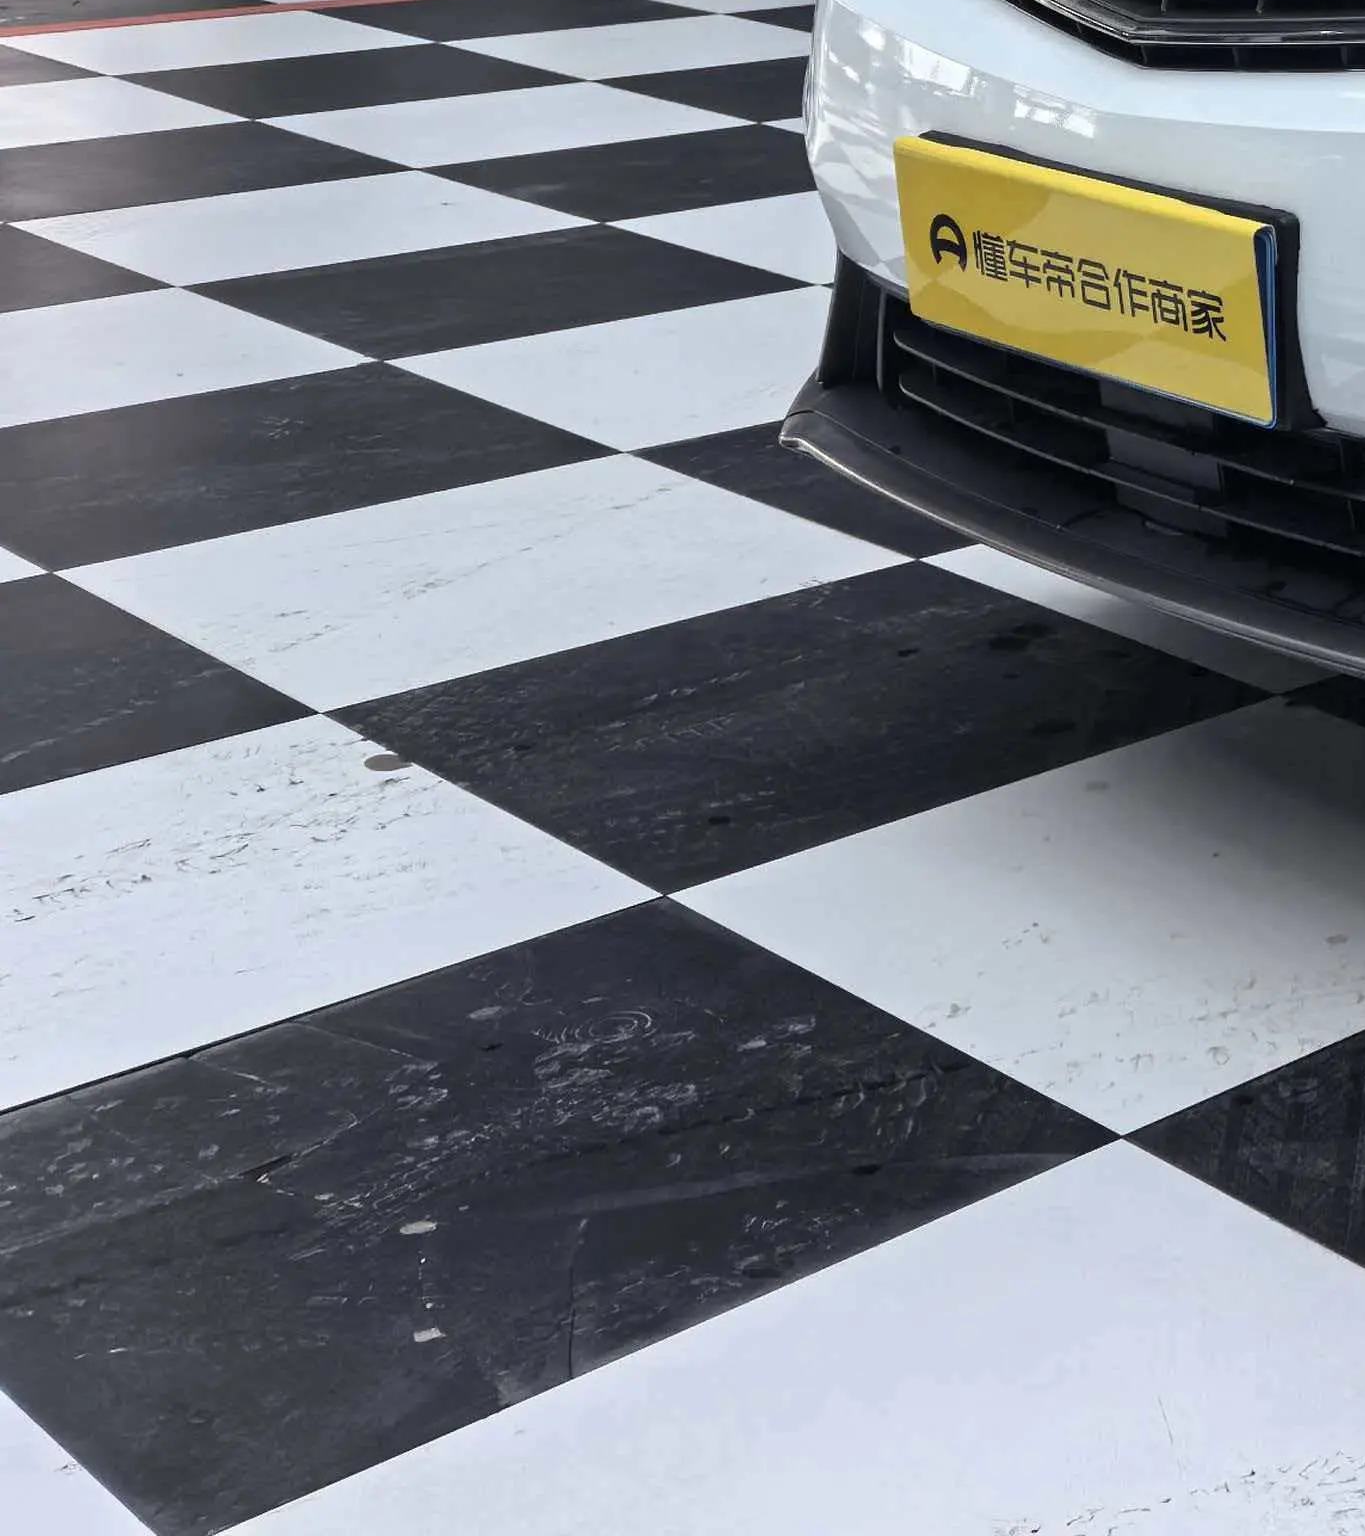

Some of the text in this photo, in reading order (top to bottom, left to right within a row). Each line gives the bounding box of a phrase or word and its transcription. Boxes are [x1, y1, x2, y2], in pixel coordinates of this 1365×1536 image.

[972, 230, 1227, 342] 懂车帝合作商家
